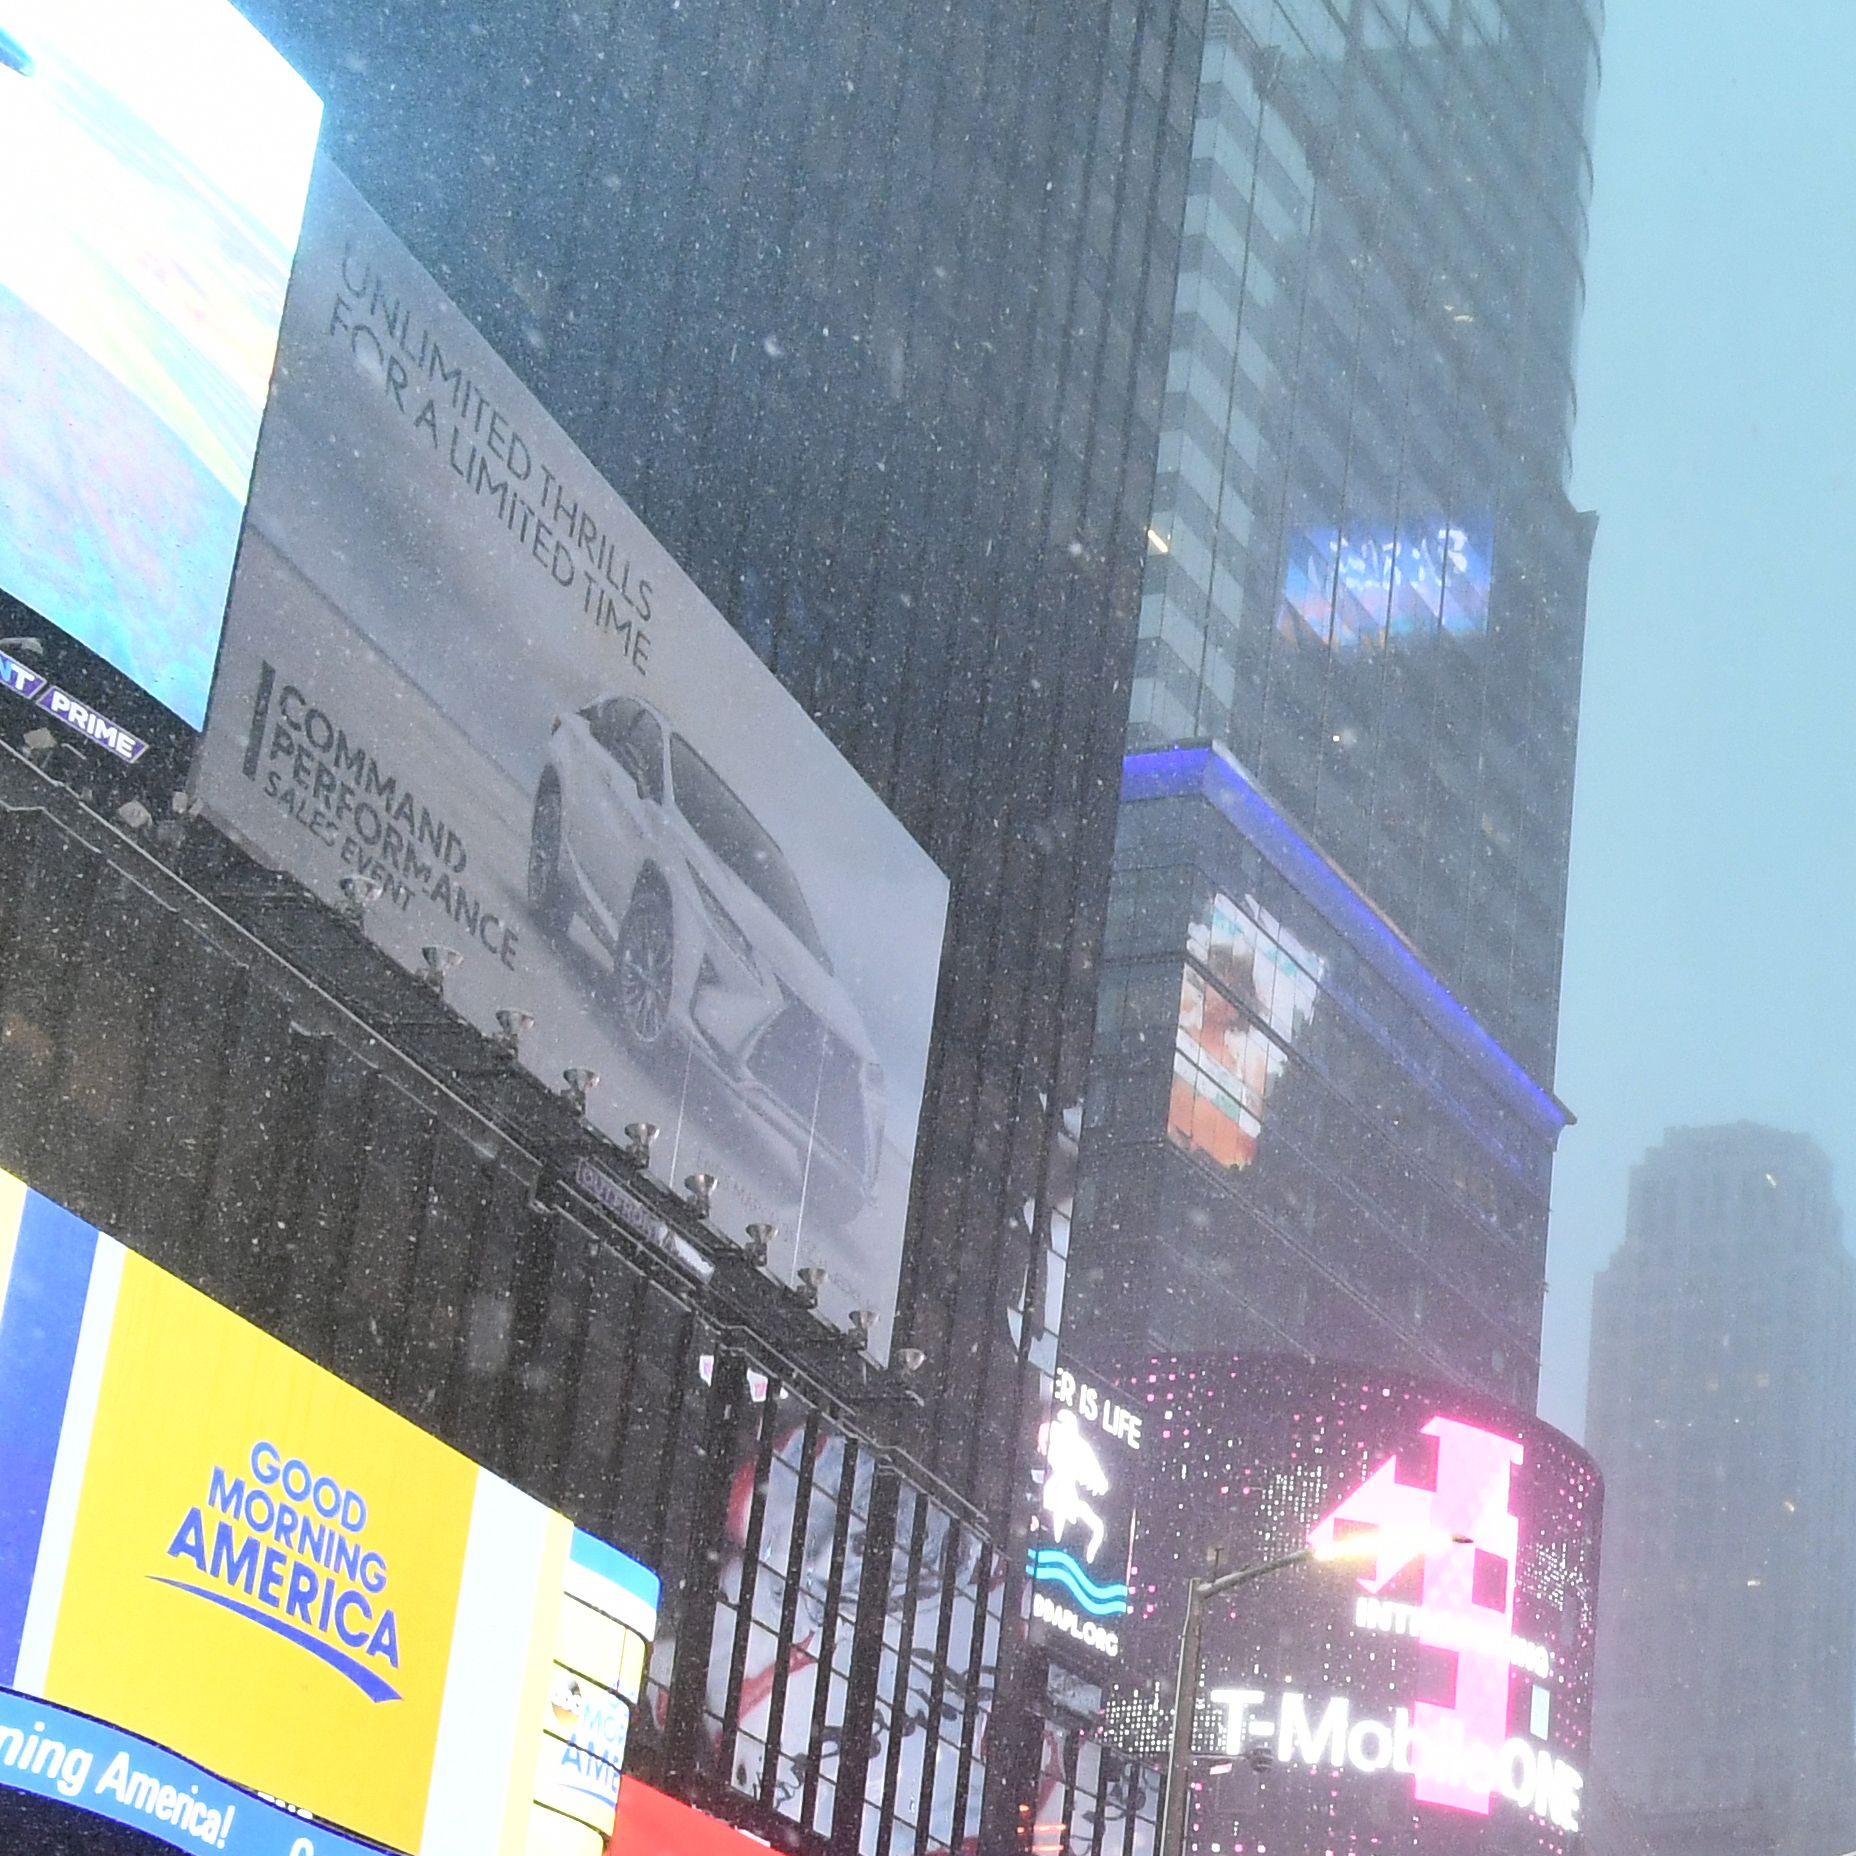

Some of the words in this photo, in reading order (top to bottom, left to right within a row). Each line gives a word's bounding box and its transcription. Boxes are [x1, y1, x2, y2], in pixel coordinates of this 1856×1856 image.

[329, 293, 409, 413] FOR
[414, 398, 440, 450] A
[450, 425, 575, 588] LIMITED
[583, 570, 653, 677] TIME
[341, 240, 532, 481] UNLIMITED
[540, 464, 654, 622] THRILLS
[51, 690, 137, 759] PRIME
[279, 685, 467, 874] COMMAND
[269, 722, 519, 972] PERFORMANCE
[251, 1441, 367, 1533] GOOD
[1080, 1384, 1098, 1421] IS
[1102, 1399, 1143, 1450] LIFE
[167, 1506, 399, 1669] AMERICA
[208, 1465, 387, 1594] MORNING
[95, 1751, 236, 1850] America!
